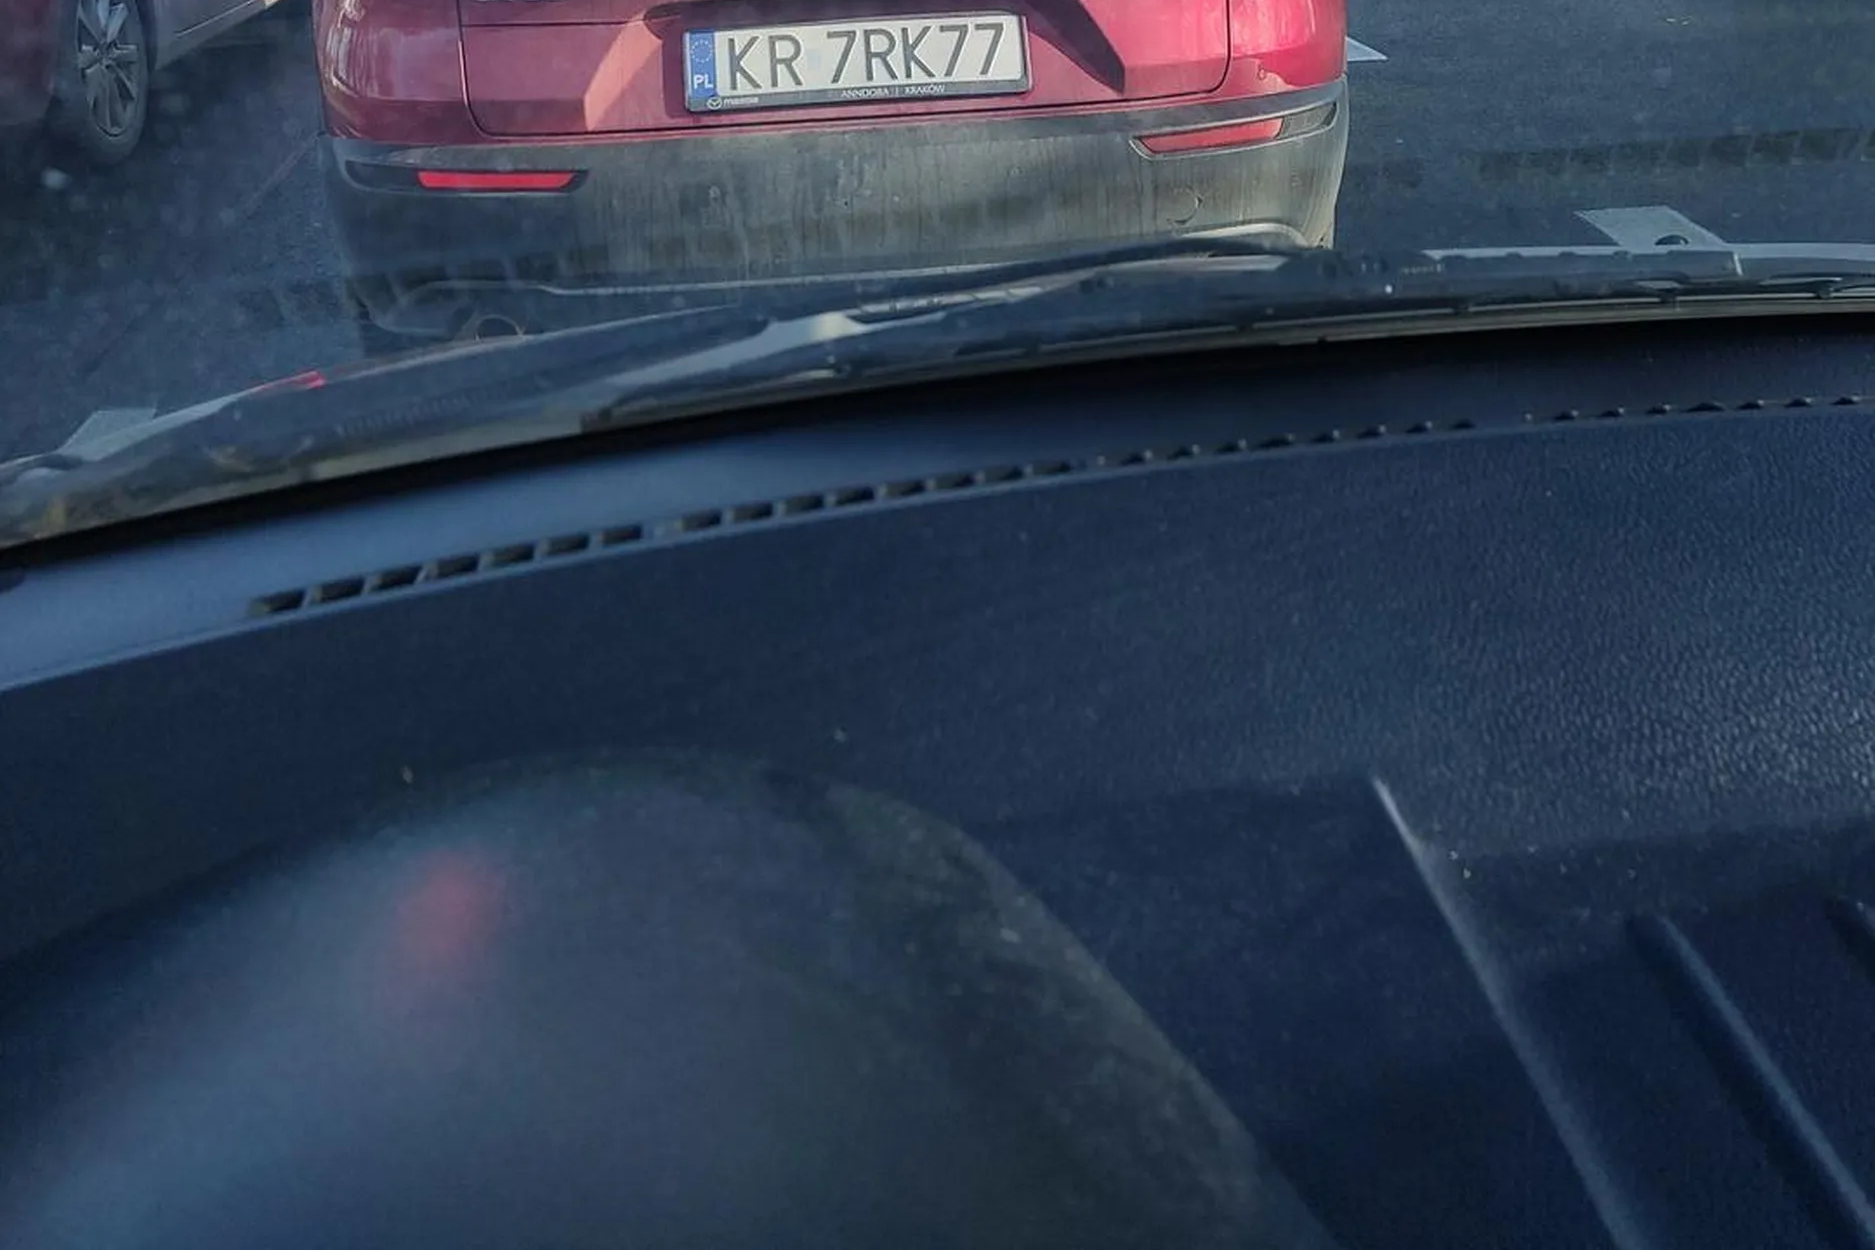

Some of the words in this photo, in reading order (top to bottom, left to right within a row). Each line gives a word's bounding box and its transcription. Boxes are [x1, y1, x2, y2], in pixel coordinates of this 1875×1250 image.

[728, 34, 804, 91] KR
[826, 23, 1005, 84] 7RK77
[693, 74, 714, 90] PL
